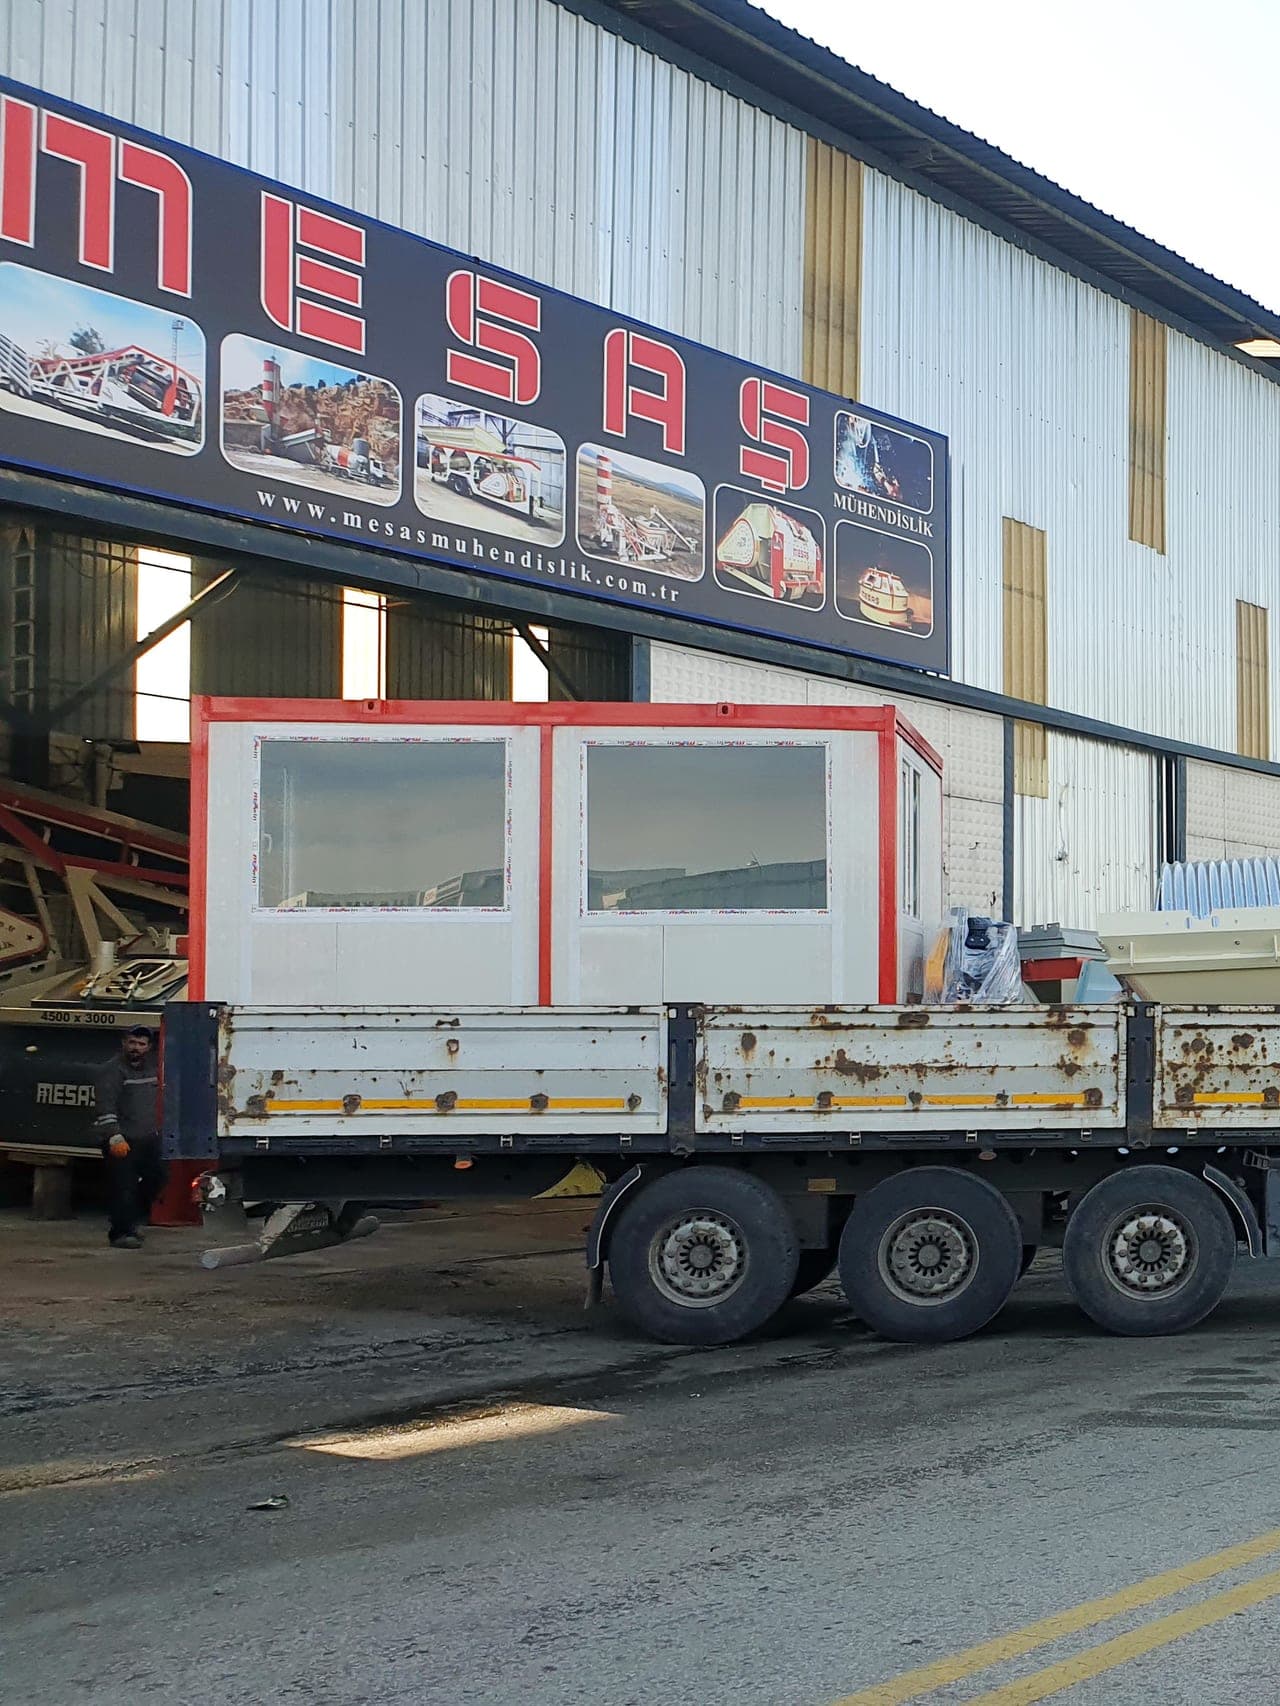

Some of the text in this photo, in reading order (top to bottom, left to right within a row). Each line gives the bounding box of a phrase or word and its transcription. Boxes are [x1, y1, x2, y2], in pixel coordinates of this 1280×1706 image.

[832, 491, 935, 538] MÜHENDİSLİK
[256, 490, 680, 602] www.mesasmuhendislik.com.tr
[40, 1010, 71, 1022] 4500
[85, 1013, 116, 1025] 3000
